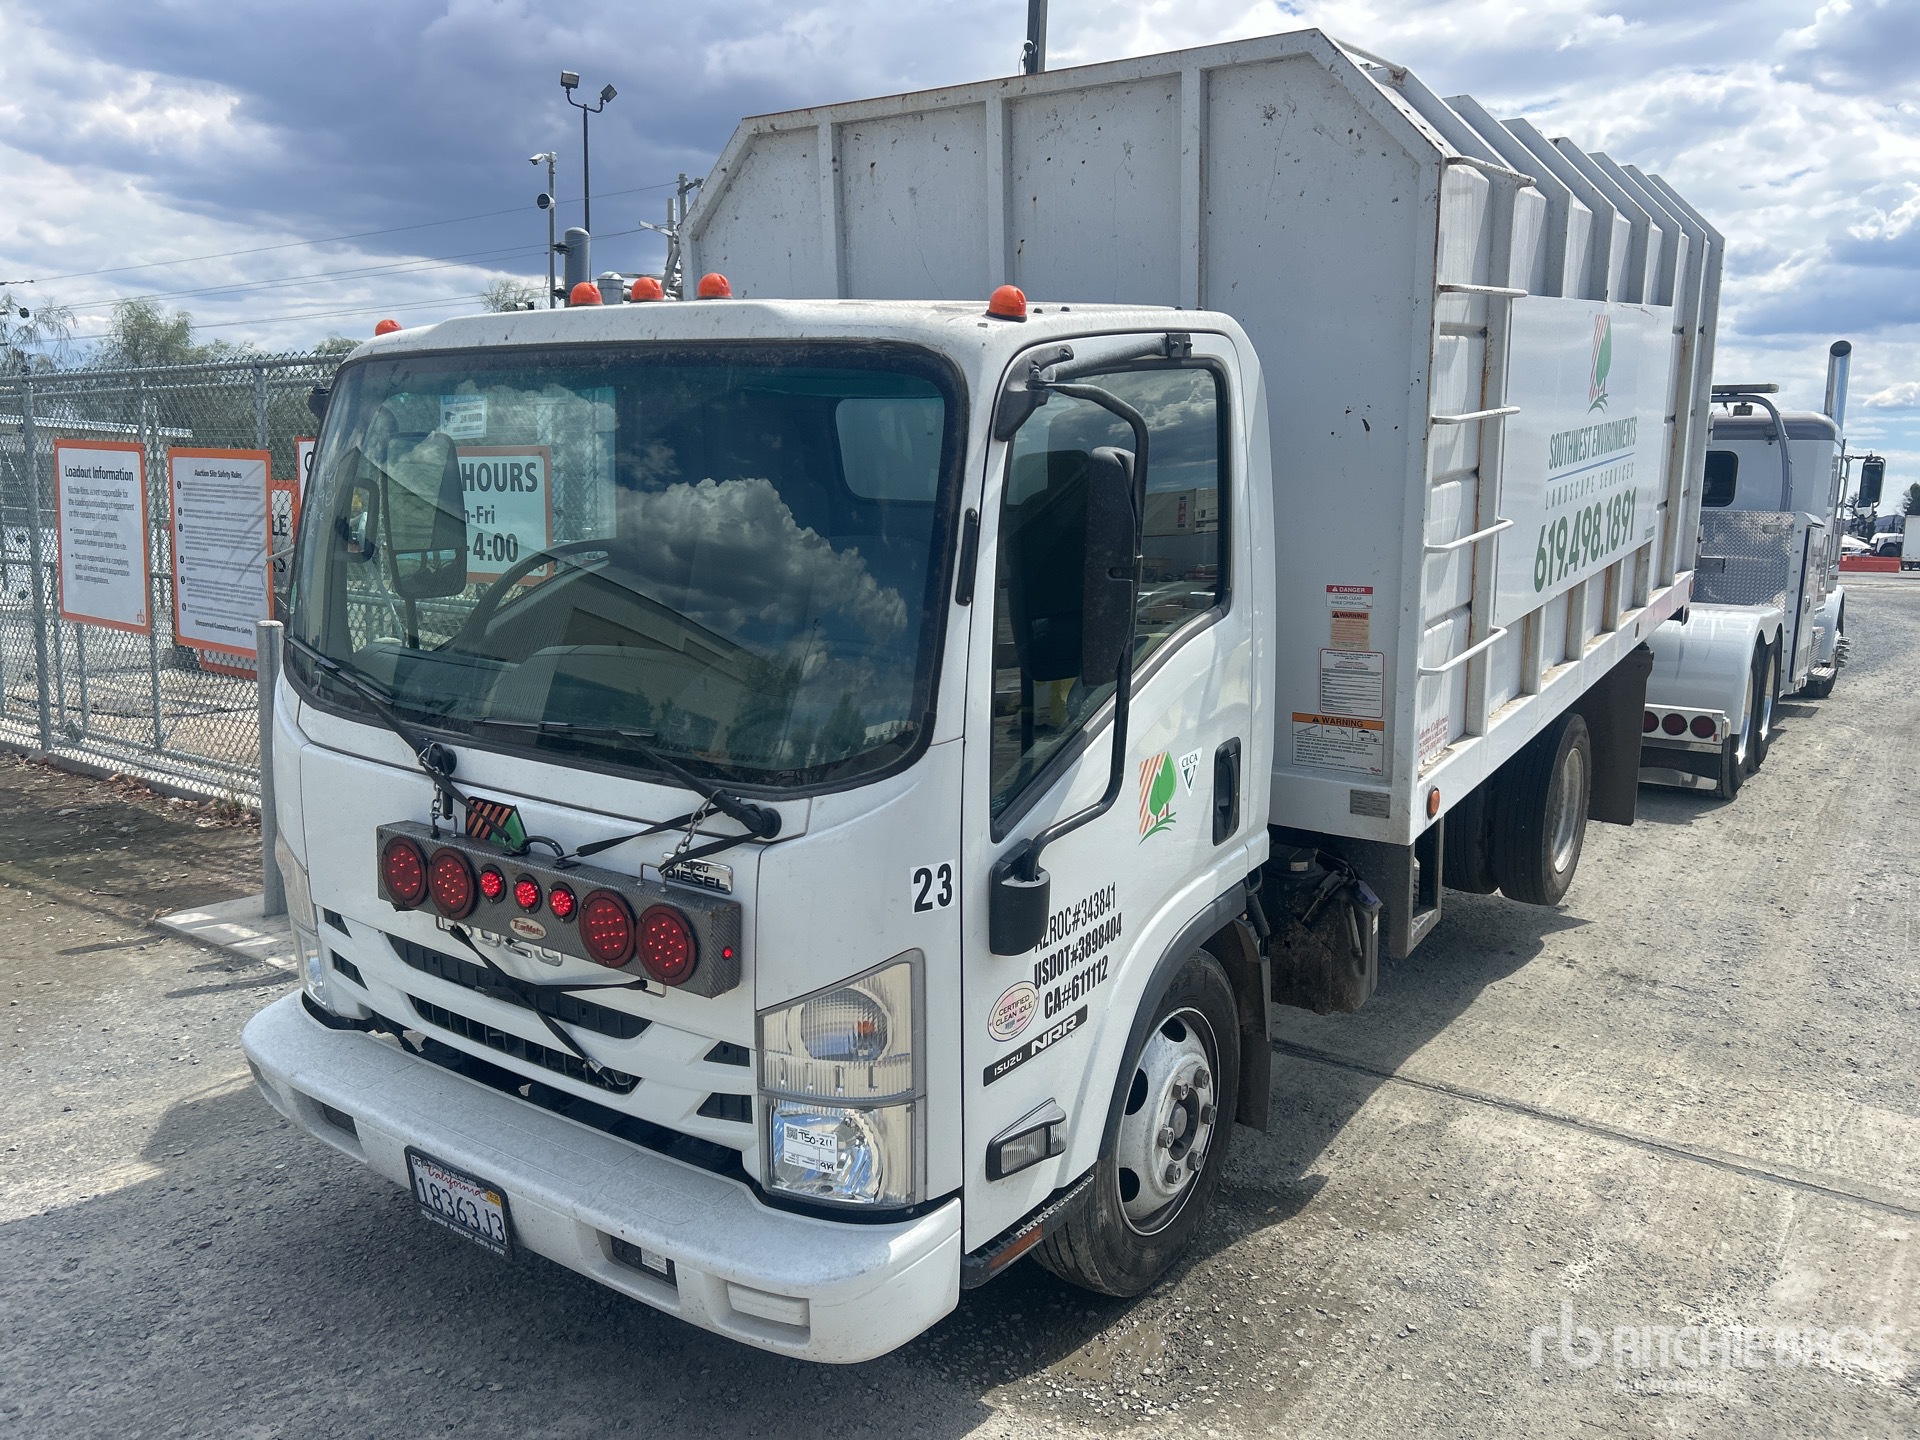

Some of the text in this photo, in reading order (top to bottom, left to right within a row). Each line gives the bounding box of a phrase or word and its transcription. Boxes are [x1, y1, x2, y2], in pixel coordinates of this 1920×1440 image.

[1549, 426, 1593, 470] SOUTHWEST
[65, 465, 134, 481] Loadout Information
[218, 470, 231, 480] Safety
[461, 462, 538, 492] HOURS
[464, 504, 495, 524] n-Fri
[1534, 487, 1637, 593] 619.498.1891
[1321, 716, 1363, 727] WARNING
[1181, 753, 1198, 768] CLCA
[914, 863, 952, 912] 23
[1034, 912, 1122, 990] USDOT#3898404
[1044, 955, 1108, 1019] CA#611112
[996, 1010, 1017, 1027] CLEAN
[1019, 1001, 1033, 1014] IDLE
[999, 995, 1029, 1016] CERTIFIED
[994, 1015, 1077, 1076] ISUZU NRR
[426, 1164, 481, 1196] California
[418, 1177, 506, 1244] 18363J3
[449, 1223, 474, 1240] TRUCK
